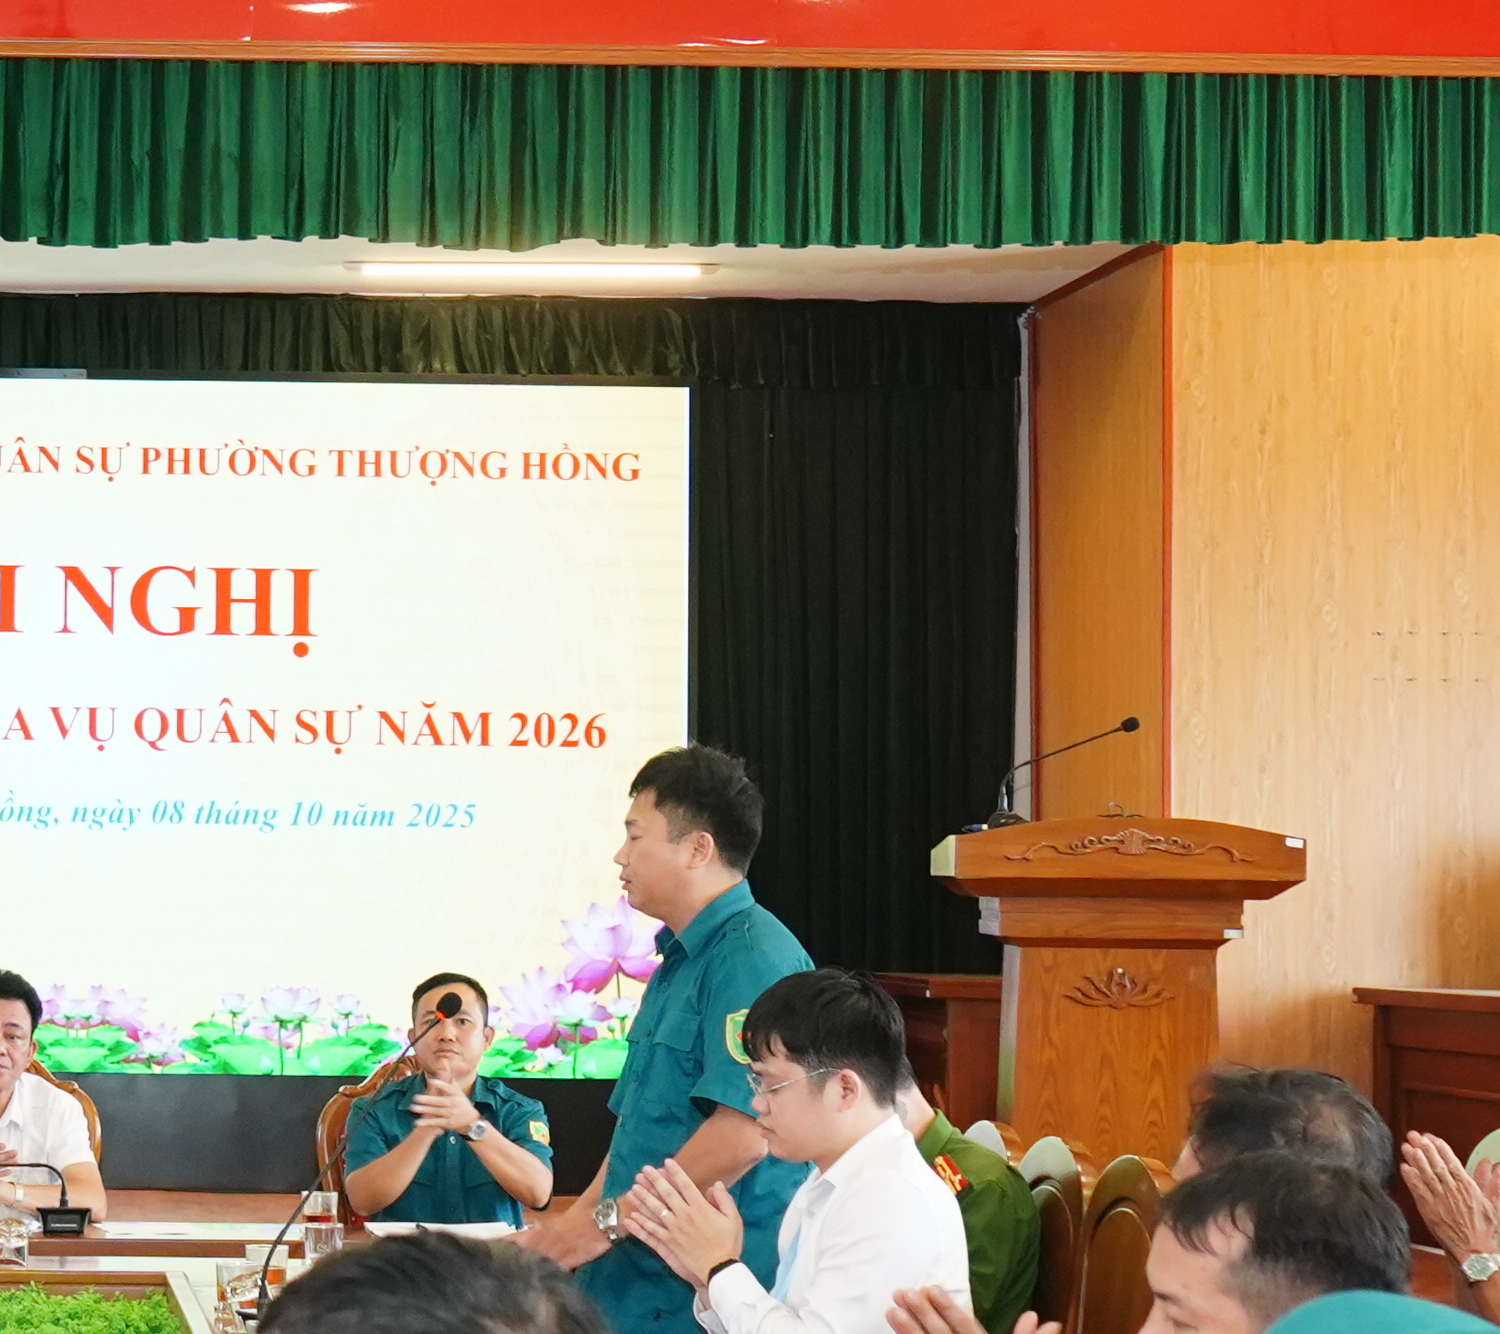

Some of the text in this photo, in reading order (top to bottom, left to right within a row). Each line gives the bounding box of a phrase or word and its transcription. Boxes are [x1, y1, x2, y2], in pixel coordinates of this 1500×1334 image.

[75, 441, 130, 482] SỰ
[141, 439, 318, 477] PHƯỜNG
[329, 445, 508, 486] THƯỢNG
[519, 443, 642, 481] HỒNG
[54, 565, 319, 658] NGHỊ
[49, 706, 118, 752] VỤ
[134, 697, 280, 751] QUÂN
[294, 703, 363, 755] SỰ
[376, 700, 494, 747] NĂM
[508, 711, 607, 748] 2026
[72, 799, 141, 831] ngày
[152, 799, 186, 825] 08
[195, 800, 279, 833] tháng
[290, 802, 323, 826] 10
[332, 802, 396, 827] năm
[406, 803, 477, 828] 2025
